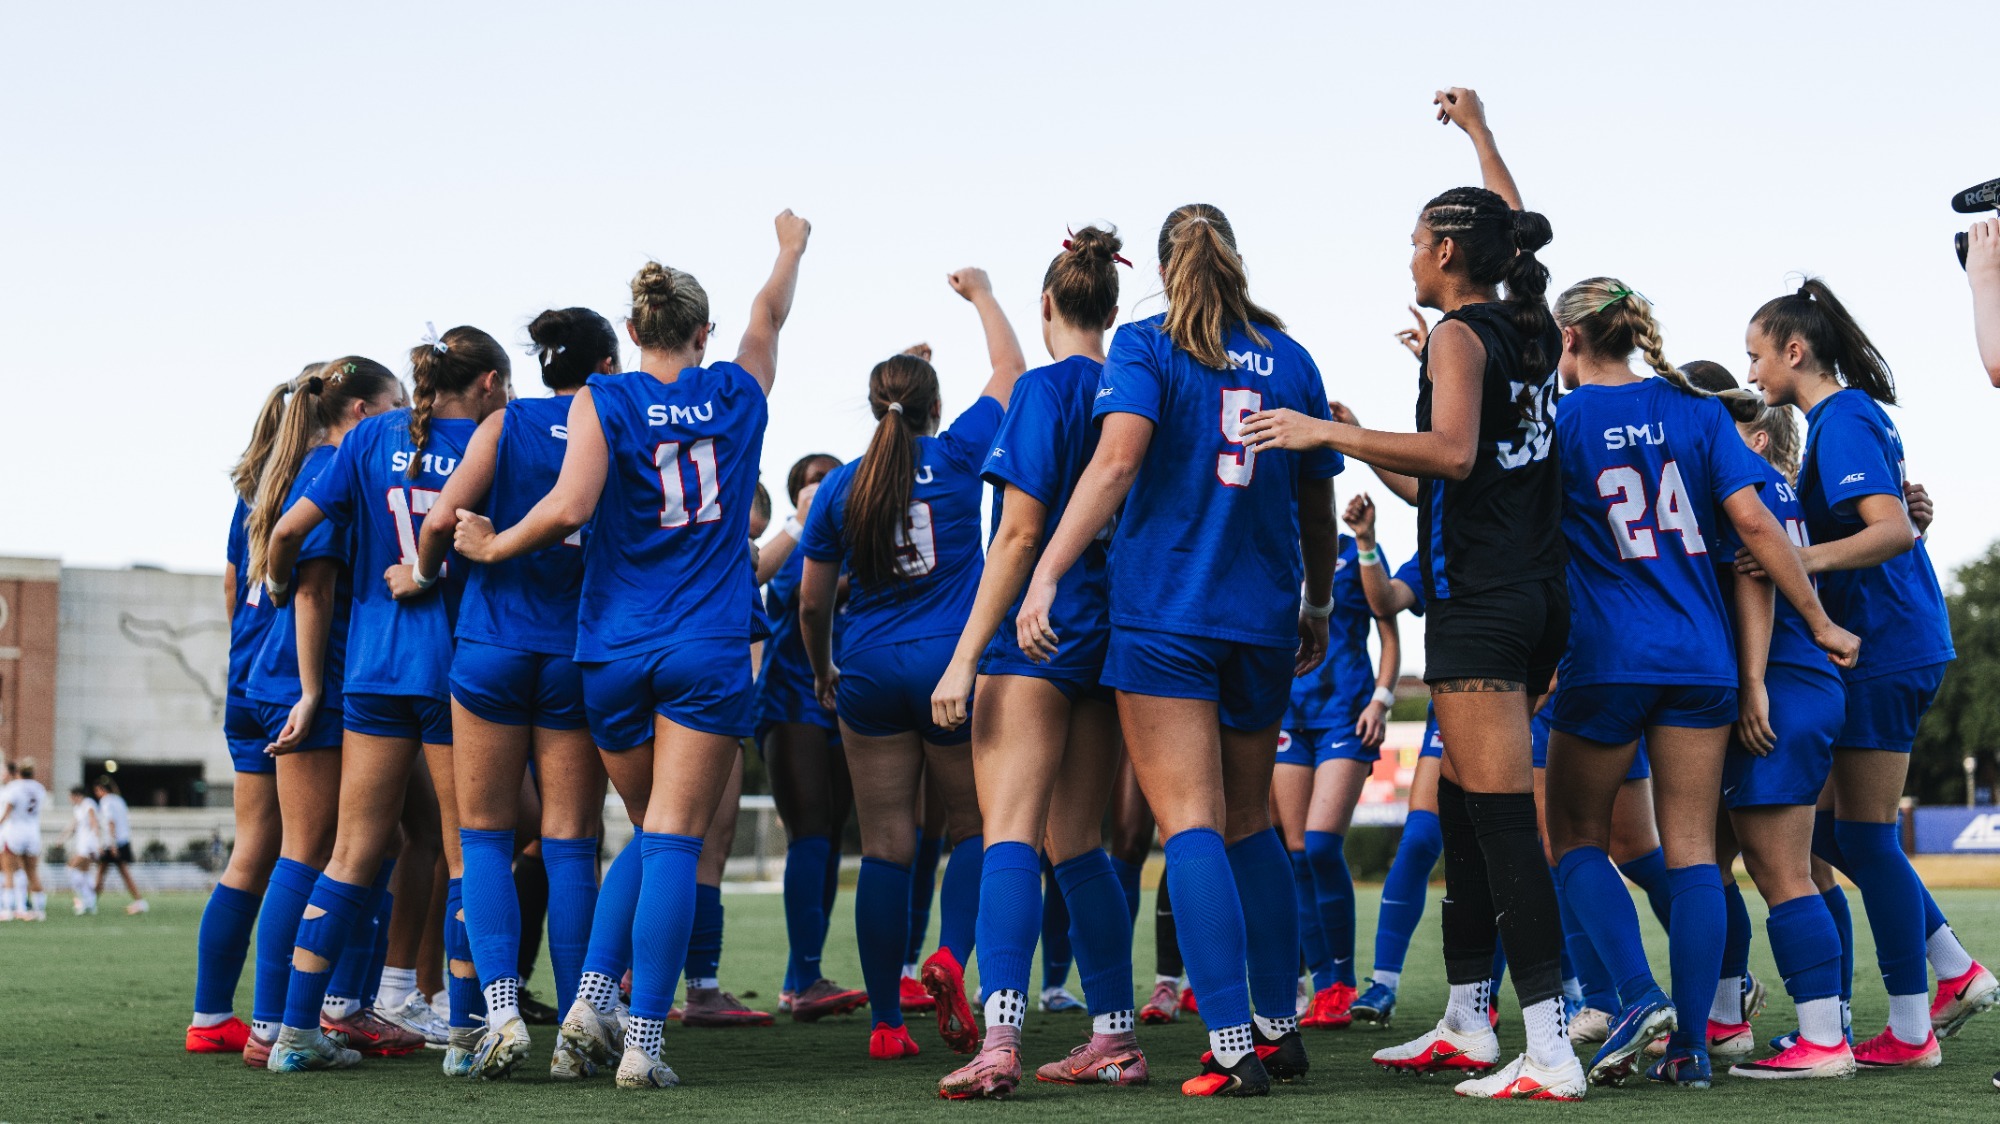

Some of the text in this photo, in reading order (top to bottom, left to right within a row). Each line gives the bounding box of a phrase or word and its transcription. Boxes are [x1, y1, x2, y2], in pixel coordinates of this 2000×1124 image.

[1218, 350, 1274, 376] MU
[647, 400, 714, 427] SMU
[1216, 387, 1262, 489] 5
[1603, 421, 1665, 450] SMU
[652, 436, 721, 529] 11
[1839, 472, 1865, 485] ACC
[1595, 457, 1708, 561] 24
